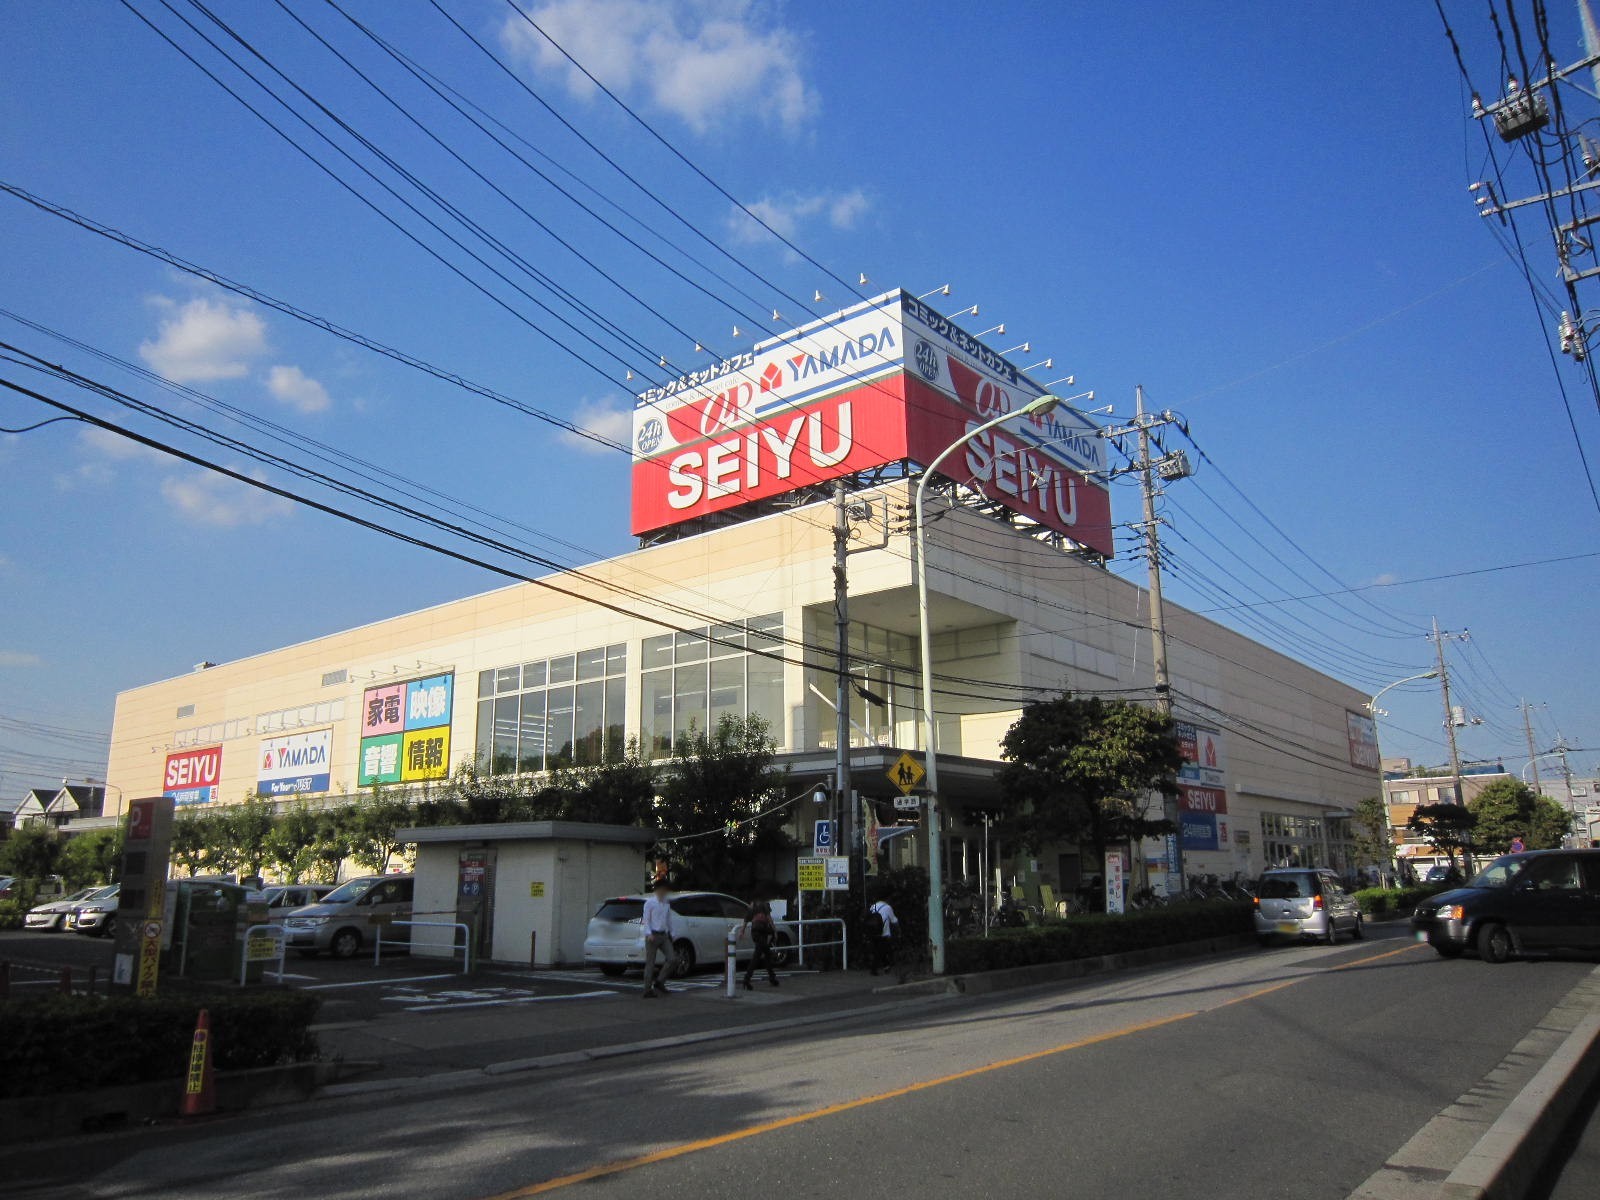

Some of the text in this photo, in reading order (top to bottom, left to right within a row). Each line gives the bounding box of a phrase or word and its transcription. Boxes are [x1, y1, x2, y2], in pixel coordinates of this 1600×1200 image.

[786, 327, 896, 382] YAMADA
[915, 341, 938, 367] 24h
[638, 422, 662, 443] 24h
[1041, 414, 1100, 466] YAMADA
[667, 401, 853, 509] SEIYU
[964, 420, 1077, 527] SEIYU
[367, 694, 400, 727] 家電
[409, 686, 446, 720] 映像
[166, 754, 218, 787] SEIYU
[278, 745, 326, 769] YAMADA
[364, 743, 398, 777] 音響
[408, 737, 443, 771] 情報
[1187, 789, 1216, 810] SEIYU
